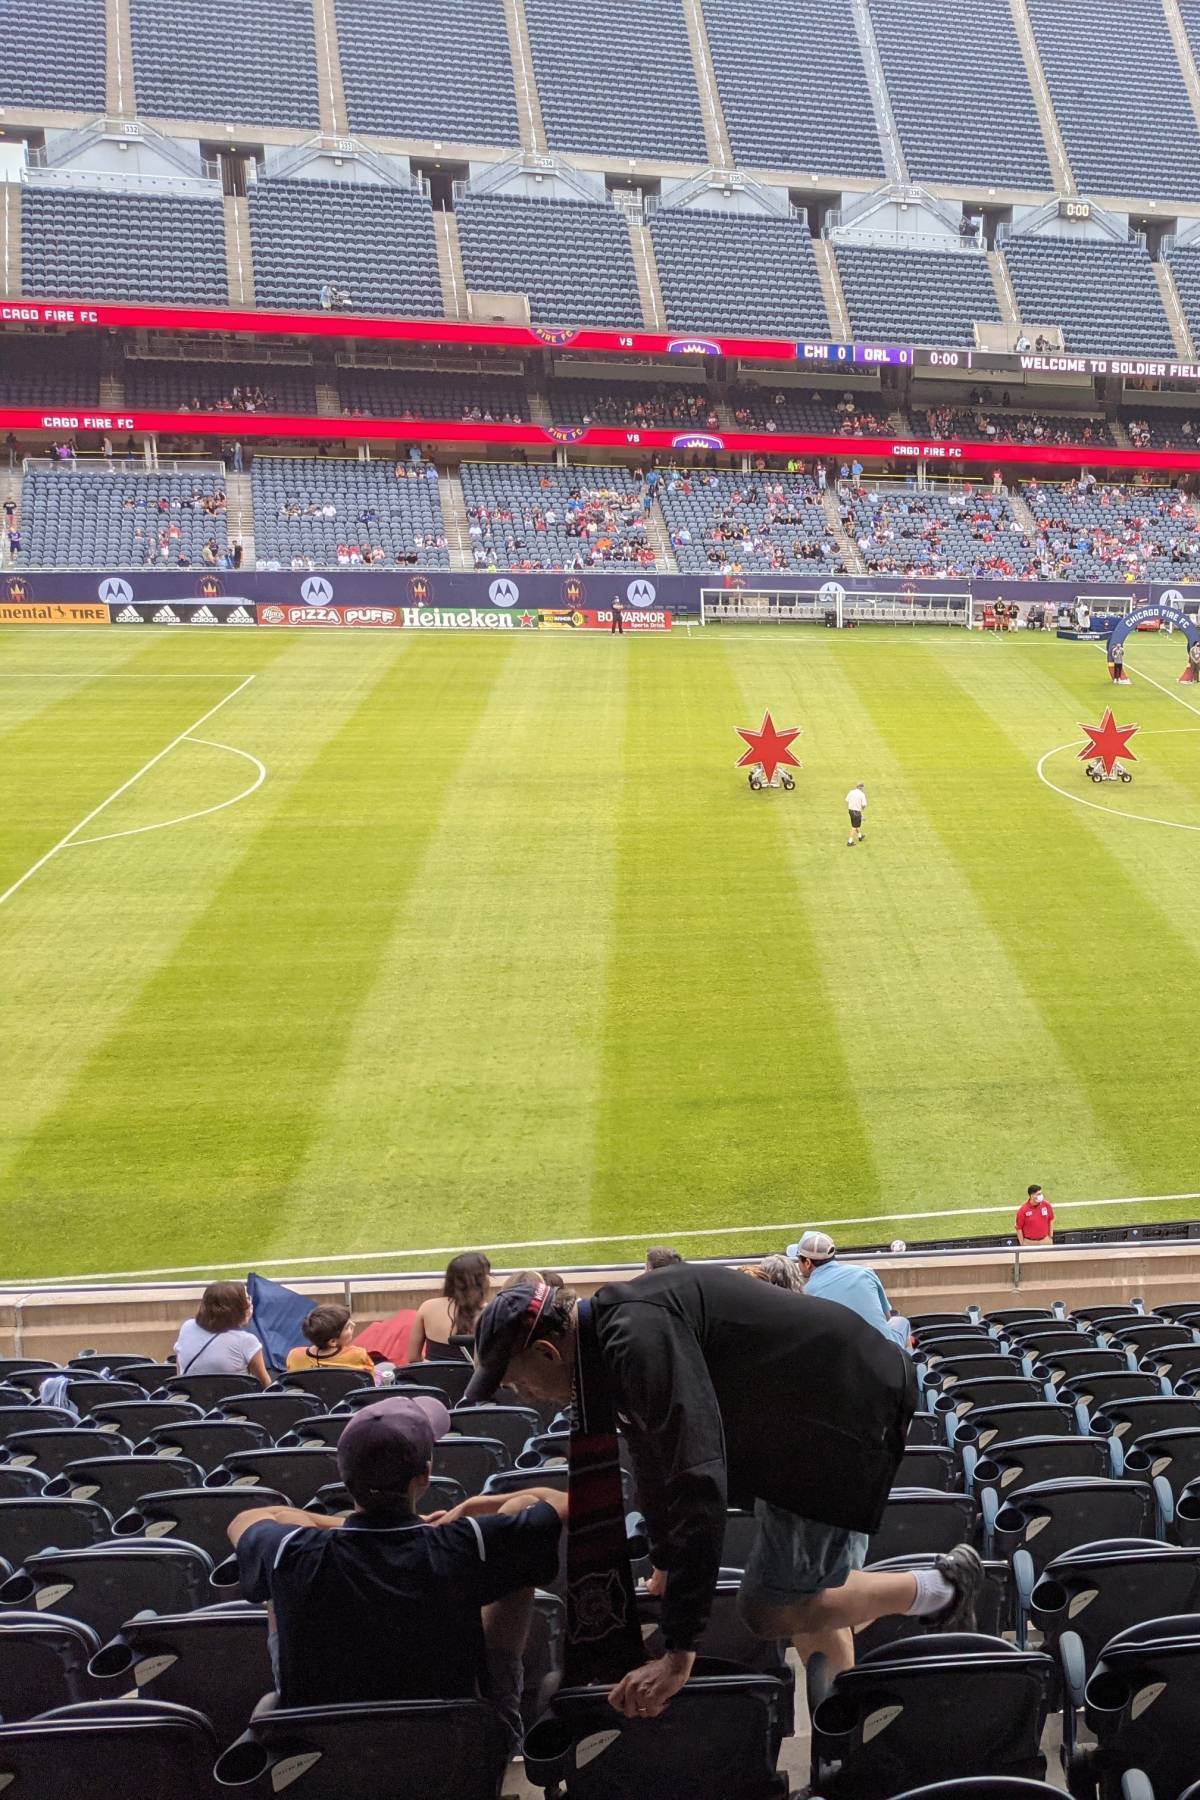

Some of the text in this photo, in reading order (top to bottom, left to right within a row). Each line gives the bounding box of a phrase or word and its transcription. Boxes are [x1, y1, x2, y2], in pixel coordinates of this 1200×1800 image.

[1066, 203, 1089, 217] 0:00
[45, 310, 75, 321] FIRE
[80, 311, 98, 322] FC
[619, 337, 633, 347] VS
[804, 345, 847, 360] CHI 0
[864, 348, 908, 363] ORL 0
[930, 352, 958, 365] 0:00
[1020, 355, 1086, 372] WELCOME
[1090, 360, 1107, 373] TO
[1111, 362, 1166, 376] SOLDIER
[84, 418, 112, 429] FIRE
[117, 418, 134, 429] FC
[548, 427, 583, 441] FIRE FC
[626, 434, 640, 443] VS
[924, 446, 945, 457] FIRE
[949, 447, 962, 458] FC
[0, 606, 105, 619] nental TIRE
[116, 614, 144, 623] adidas
[152, 615, 181, 623] adidas
[289, 607, 341, 624] PIZZA
[344, 608, 396, 625] PUFF
[401, 608, 514, 628] Heineken
[597, 610, 665, 623] BOYARMOR
[1125, 608, 1190, 629] CHICAGO FIRE FC
[190, 615, 219, 624] adidas
[226, 616, 255, 624] adidas
